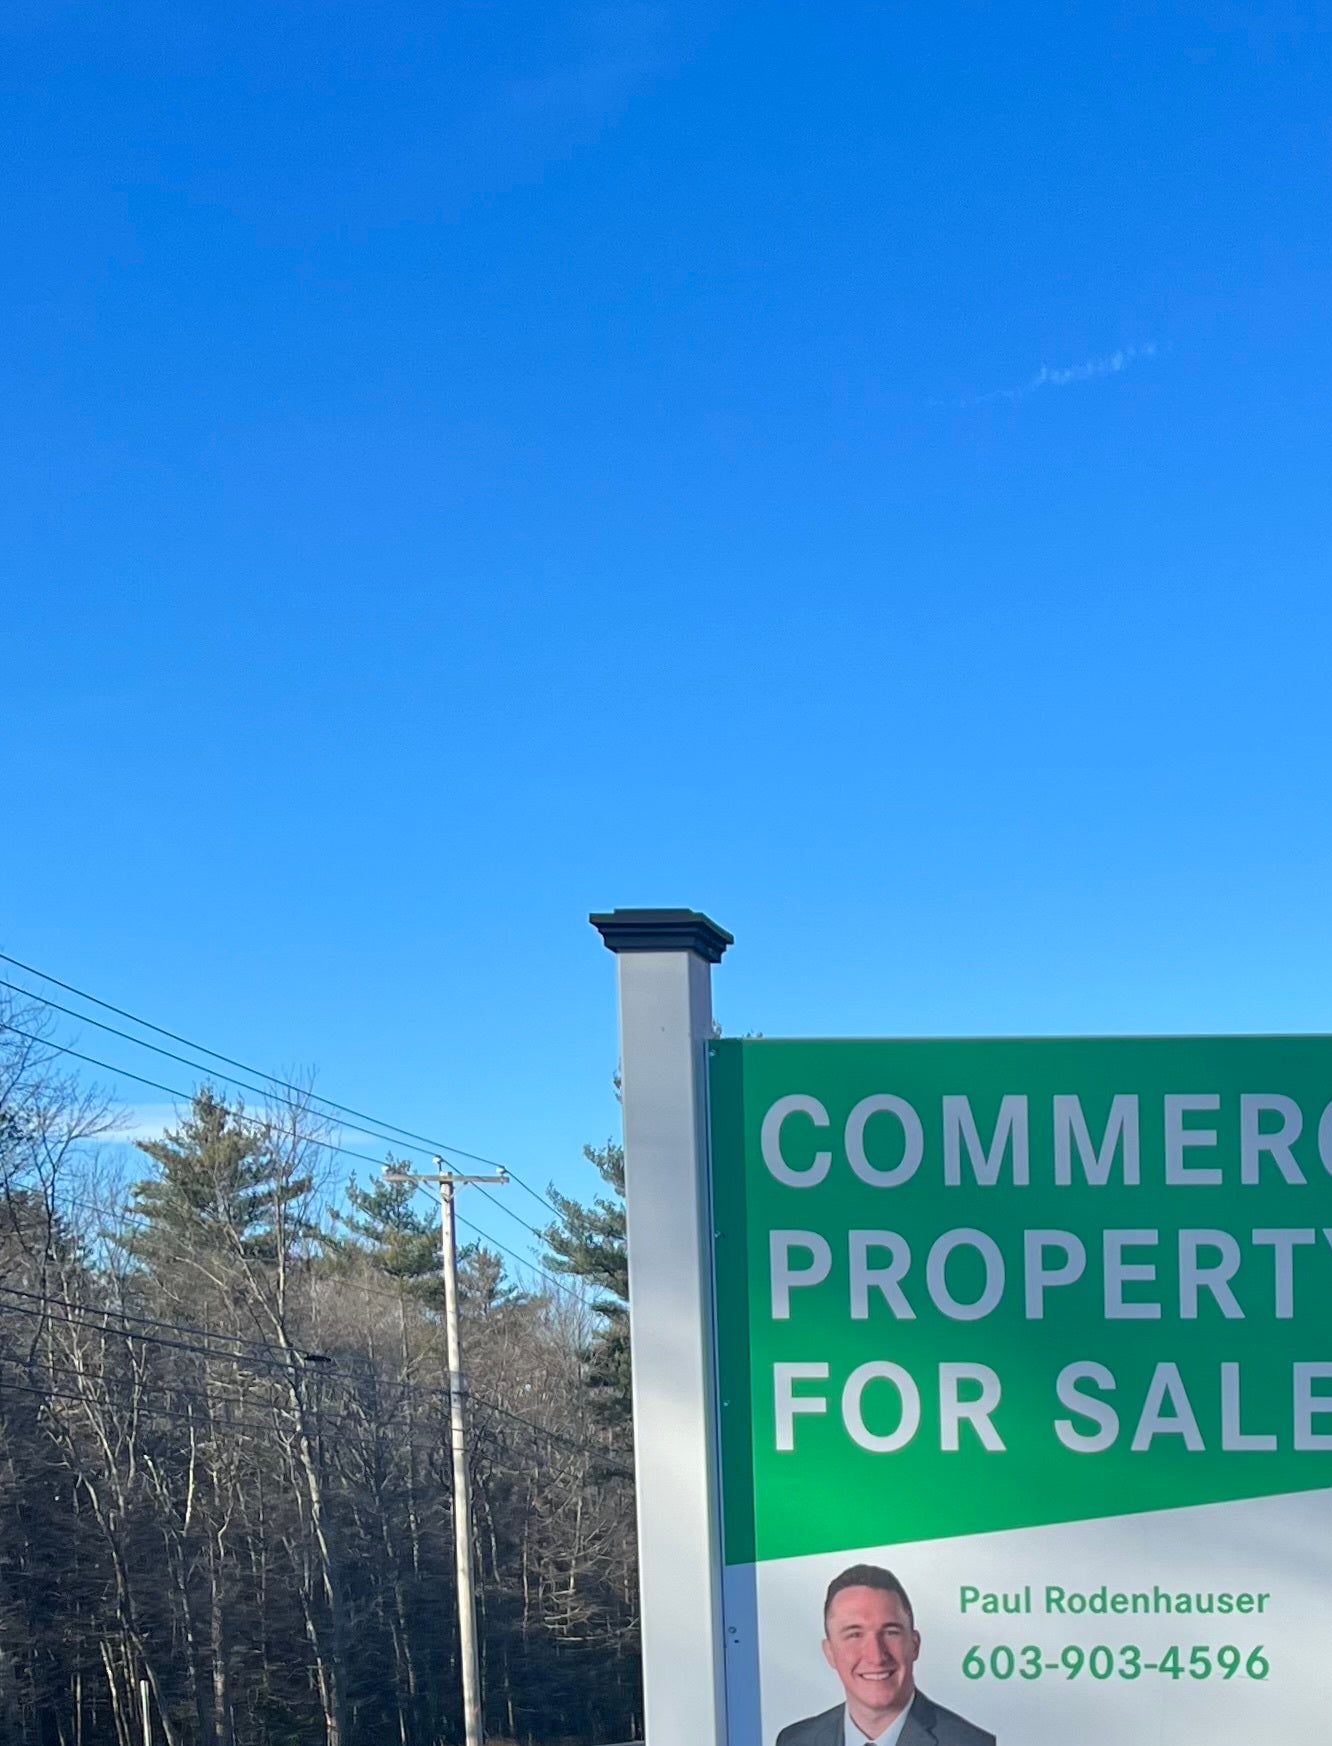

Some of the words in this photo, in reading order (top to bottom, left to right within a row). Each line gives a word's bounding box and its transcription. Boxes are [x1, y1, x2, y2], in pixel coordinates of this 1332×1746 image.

[773, 1360, 1007, 1454] FOR
[960, 1585, 1032, 1614] Paul
[1045, 1585, 1271, 1614] Rodenhauser
[961, 1644, 1270, 1681] 603-903-4596
